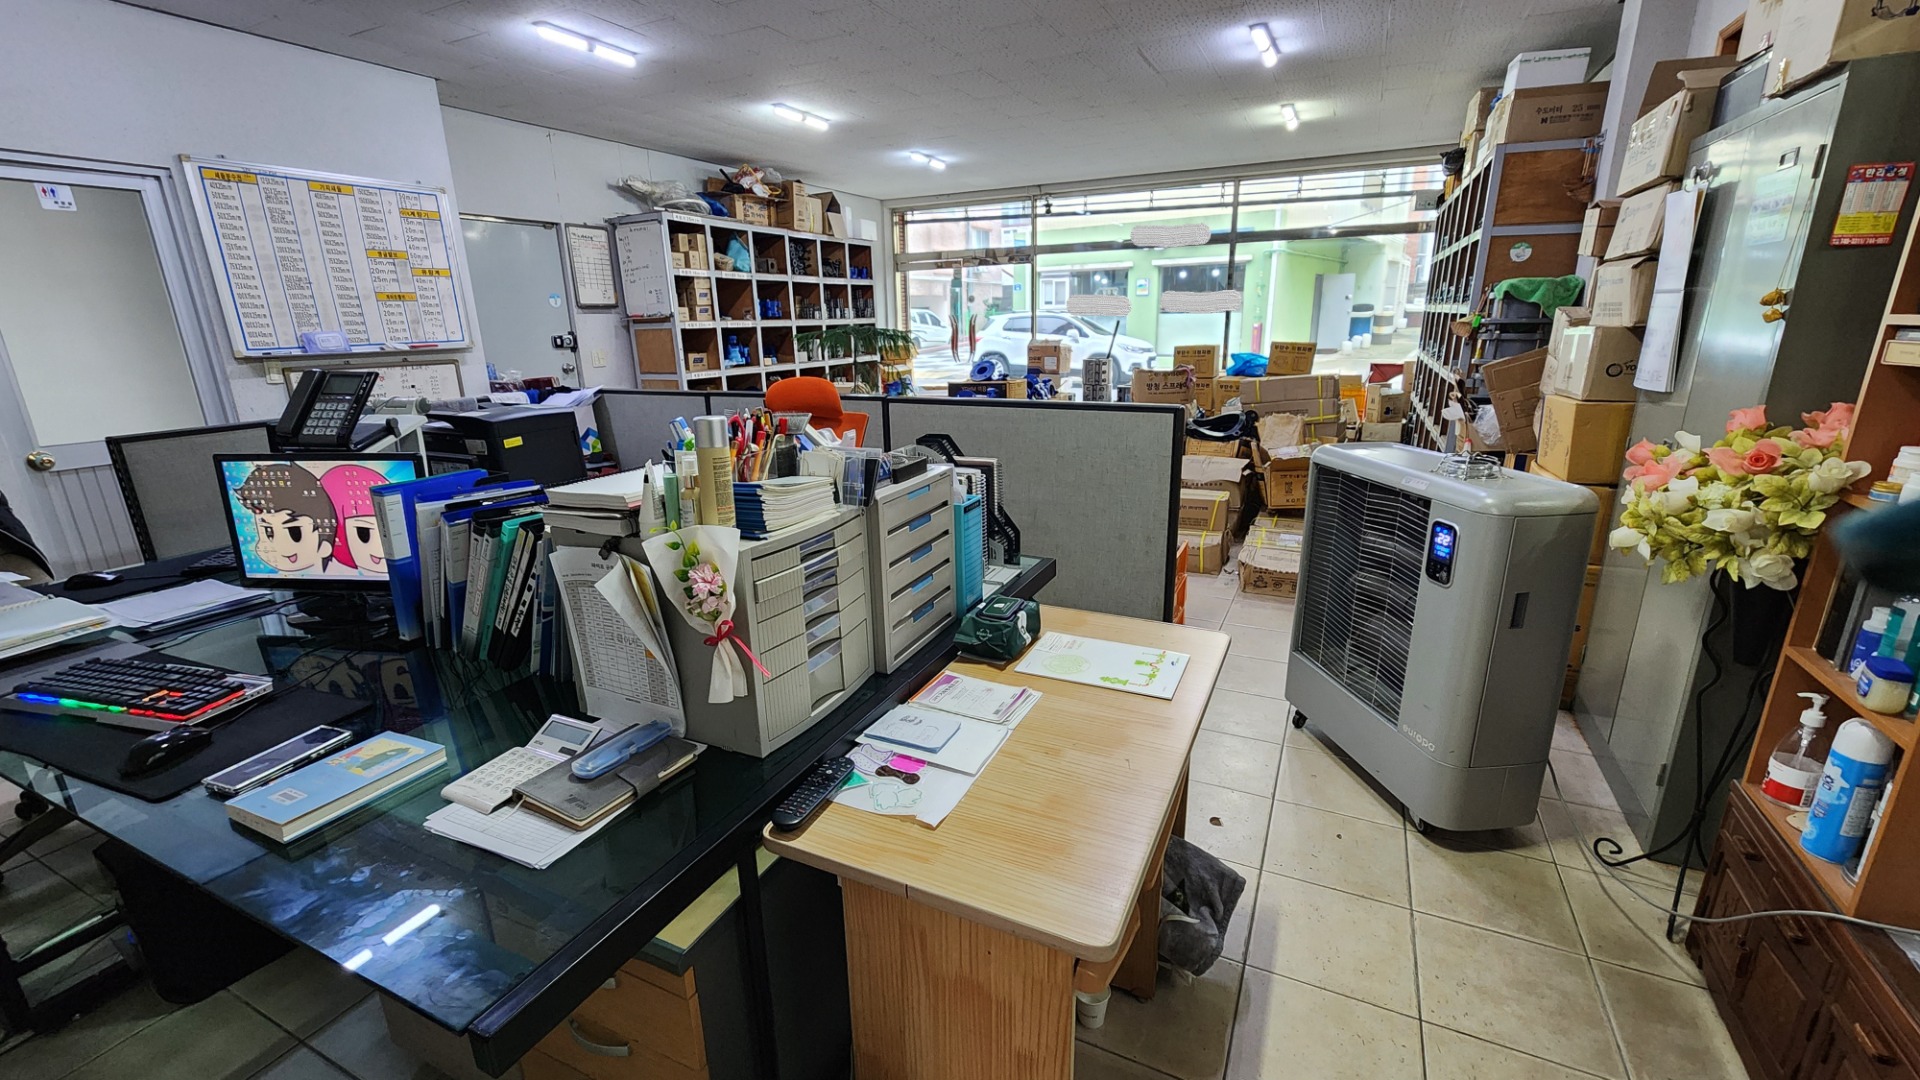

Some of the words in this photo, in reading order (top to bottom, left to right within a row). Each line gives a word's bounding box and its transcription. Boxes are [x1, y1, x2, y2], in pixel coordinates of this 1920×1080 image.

[1572, 103, 1583, 112] 25
[1146, 382, 1160, 391] 방청
[1437, 532, 1451, 546] 22
